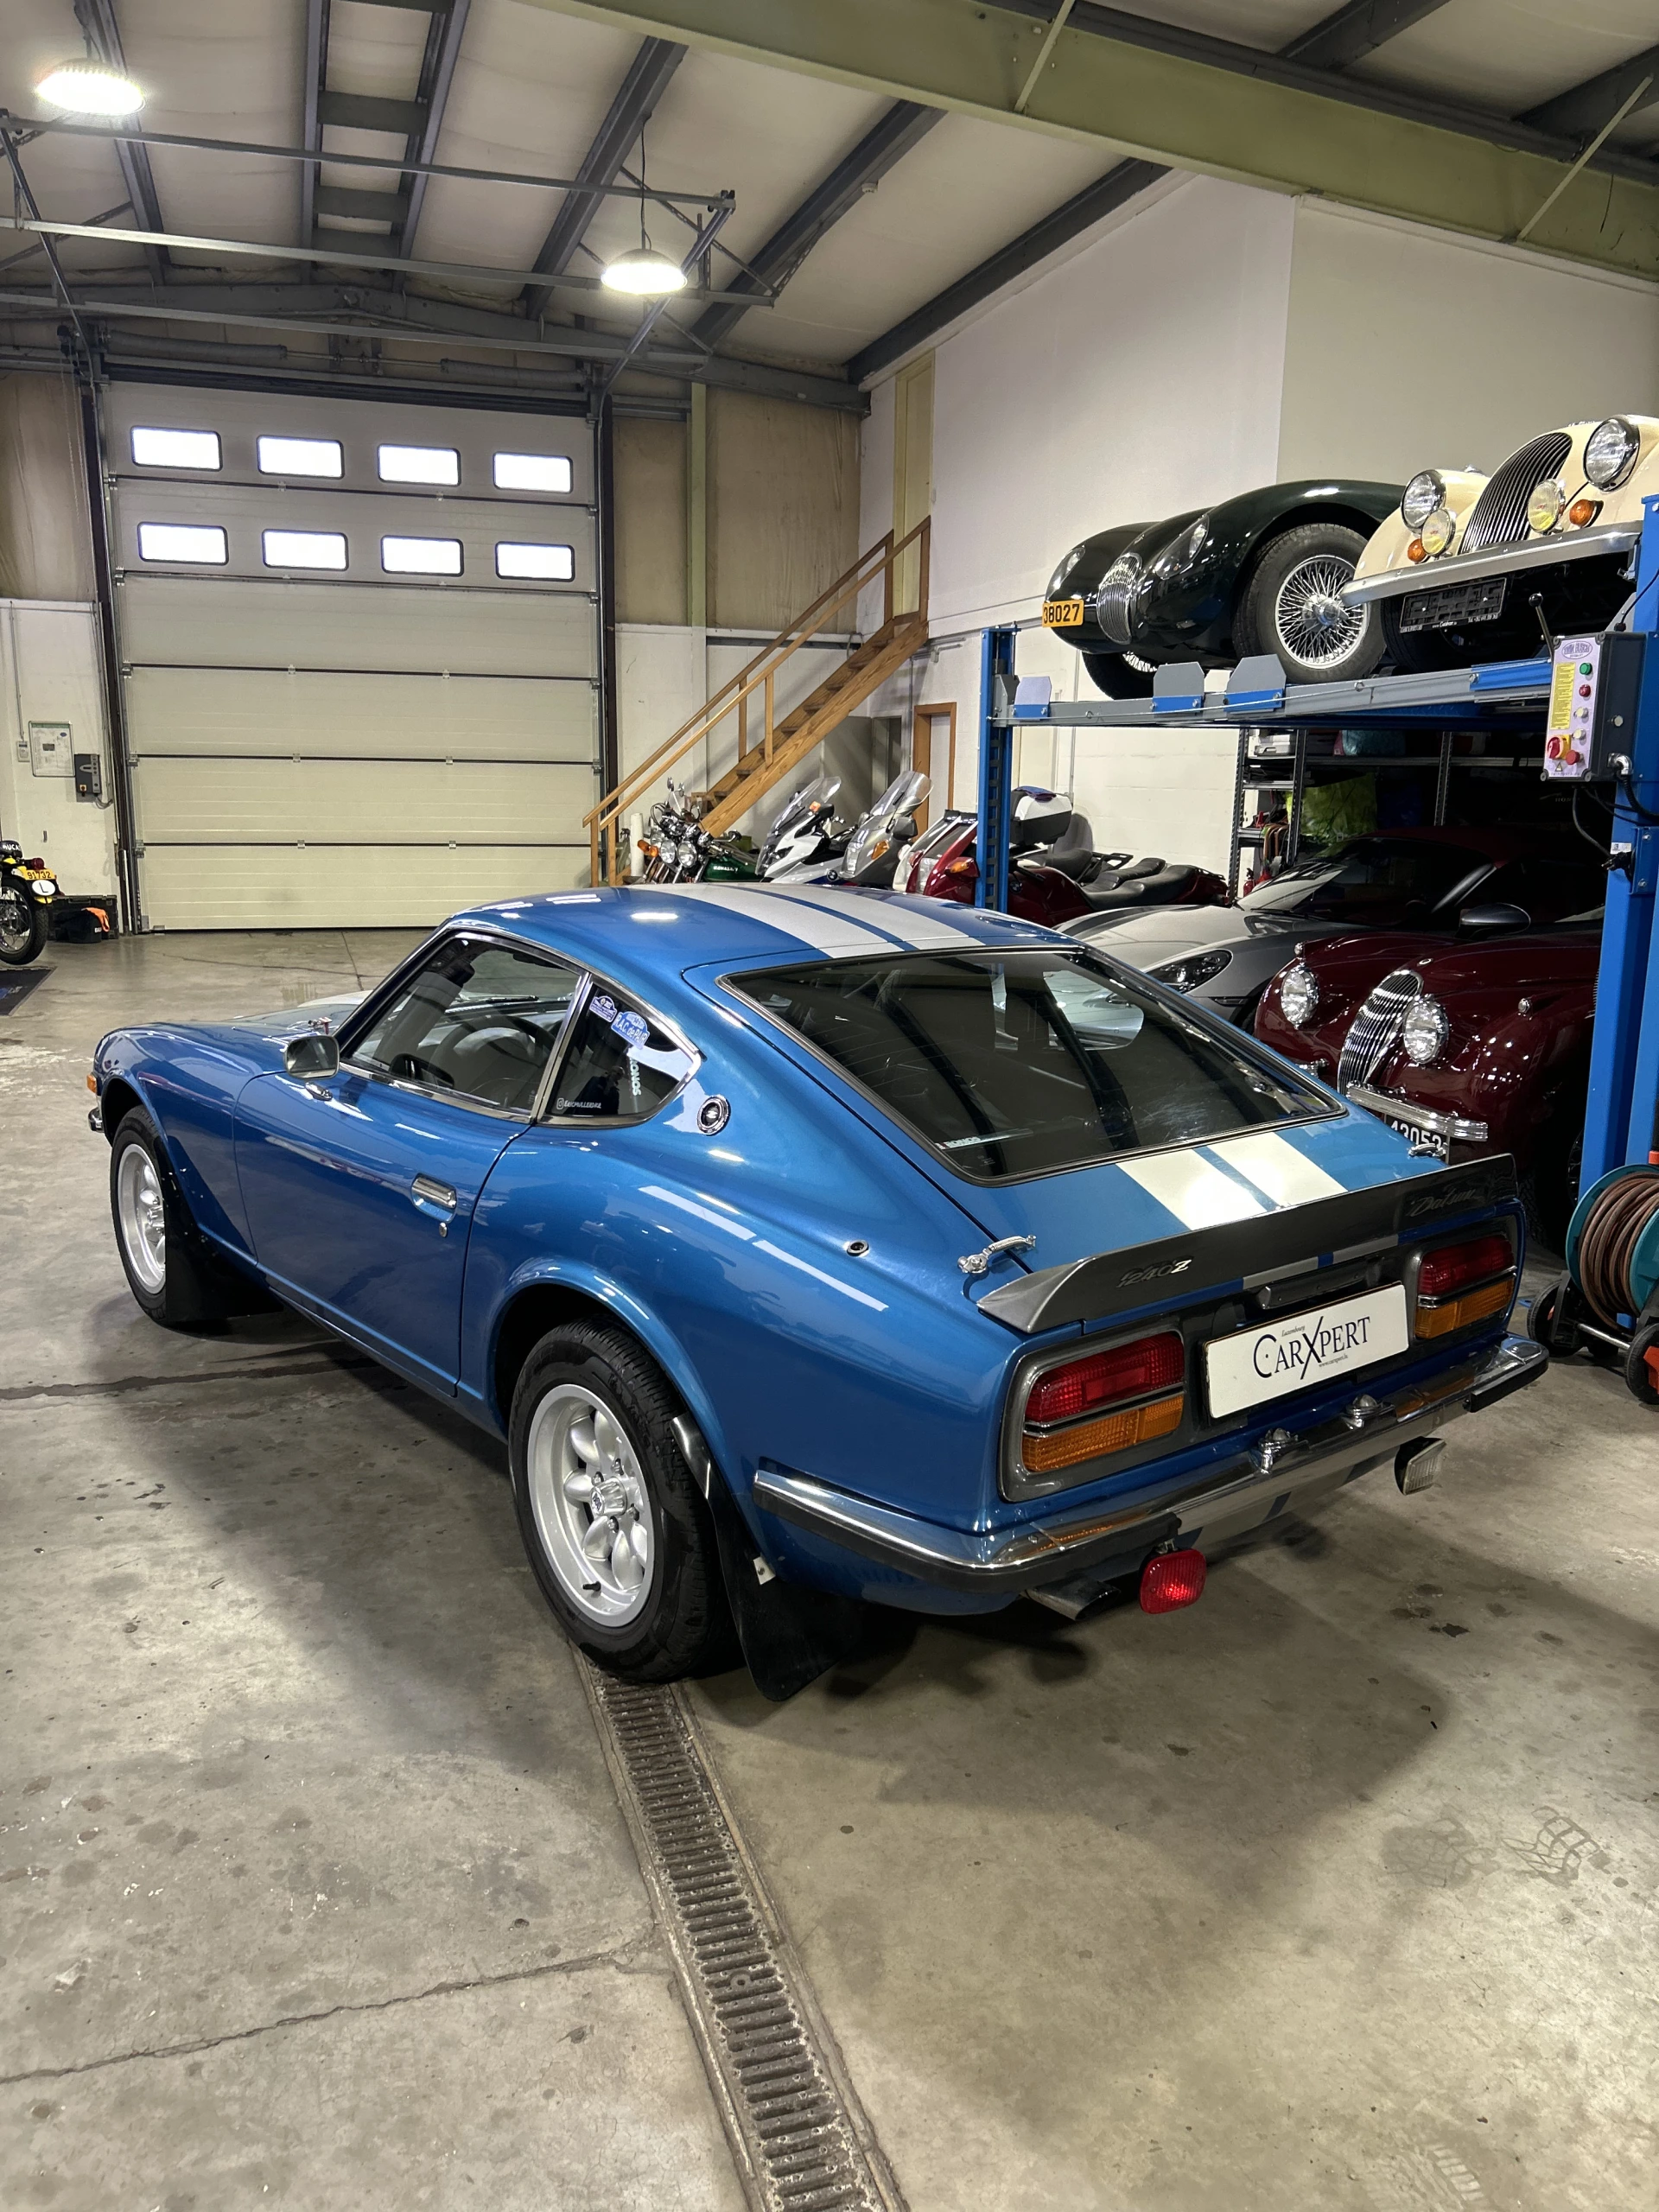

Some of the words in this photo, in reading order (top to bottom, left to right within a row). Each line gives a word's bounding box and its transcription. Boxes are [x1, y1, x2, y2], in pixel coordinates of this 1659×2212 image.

[1043, 603, 1080, 624] 38027
[27, 871, 52, 880] 91732
[39, 881, 48, 893] L
